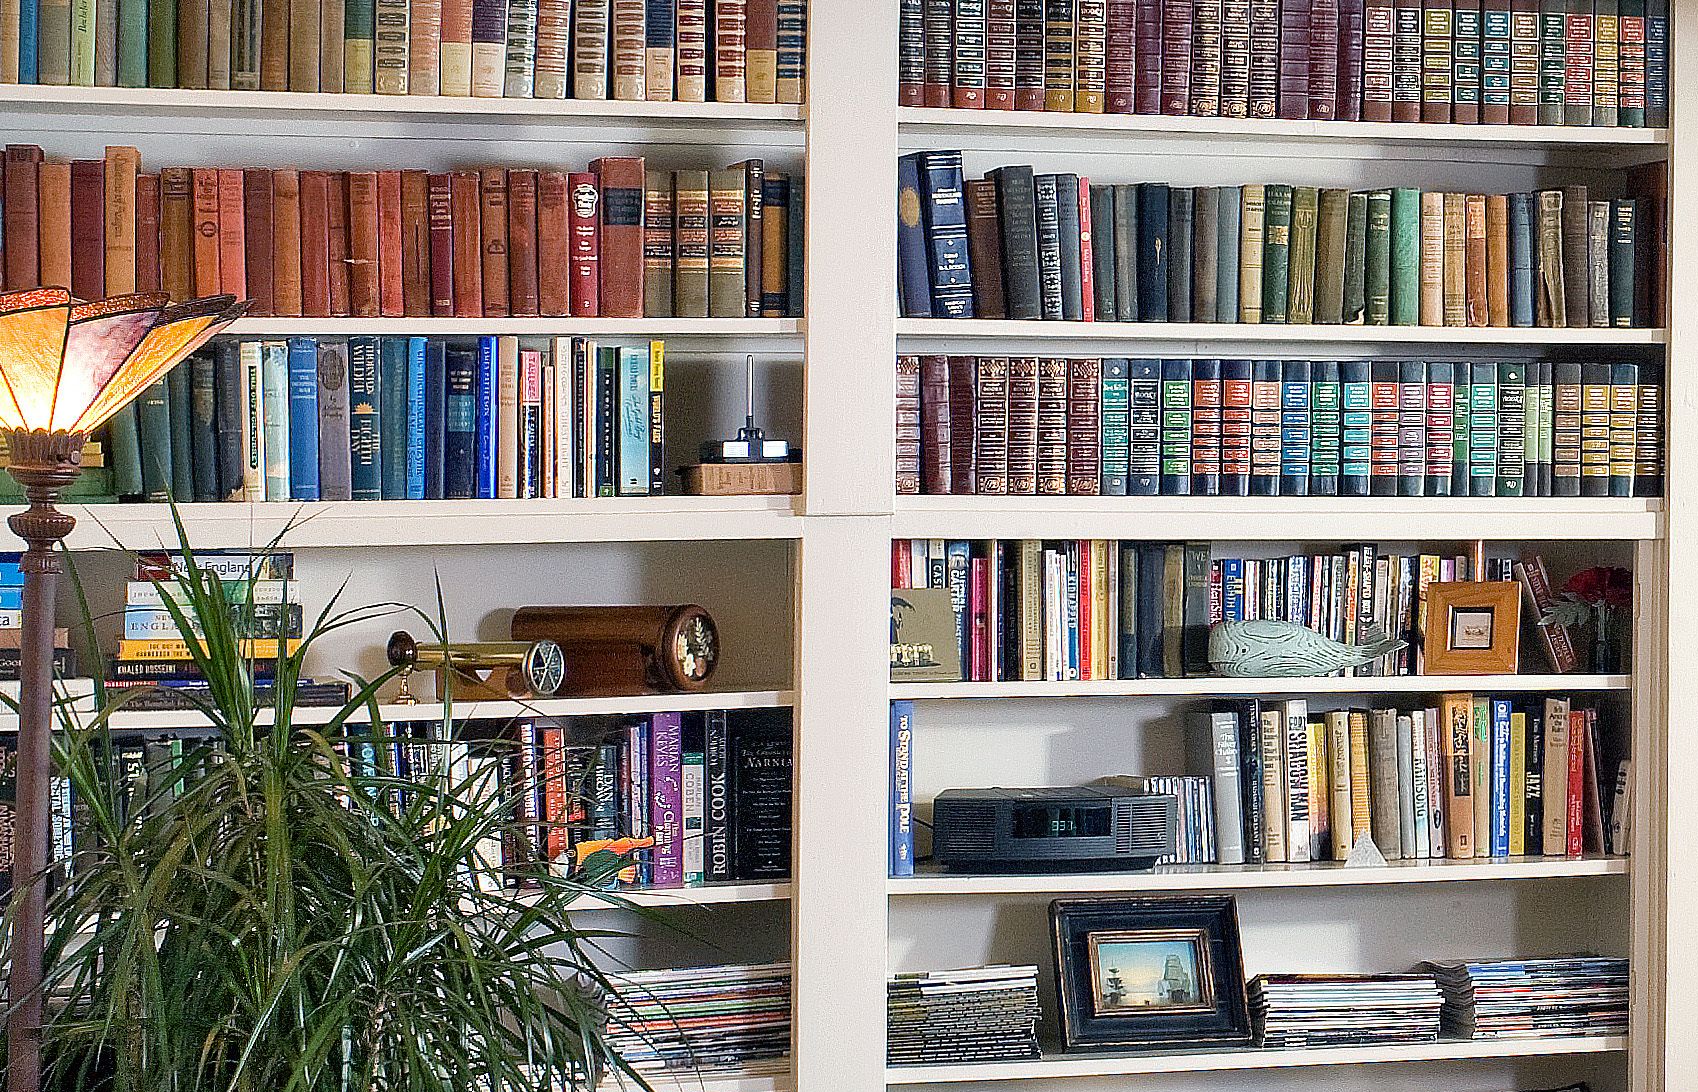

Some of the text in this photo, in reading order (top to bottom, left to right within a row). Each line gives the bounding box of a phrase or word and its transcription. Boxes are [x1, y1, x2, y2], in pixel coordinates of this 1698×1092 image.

[353, 345, 364, 392] WILDER
[950, 570, 960, 612] CARTER
[1226, 576, 1236, 608] EIGHTH
[900, 715, 909, 729] TO
[656, 731, 668, 768] KEYES
[668, 725, 679, 772] MARIAN
[745, 757, 793, 768] NARNIA
[897, 730, 911, 771] STAND
[1288, 733, 1308, 790] SHADOW
[604, 774, 614, 801] DAN
[685, 773, 695, 812] COBEN
[1526, 771, 1541, 799] JAZZ
[711, 772, 726, 874] ROBIN COOK
[1290, 793, 1308, 821] MAN
